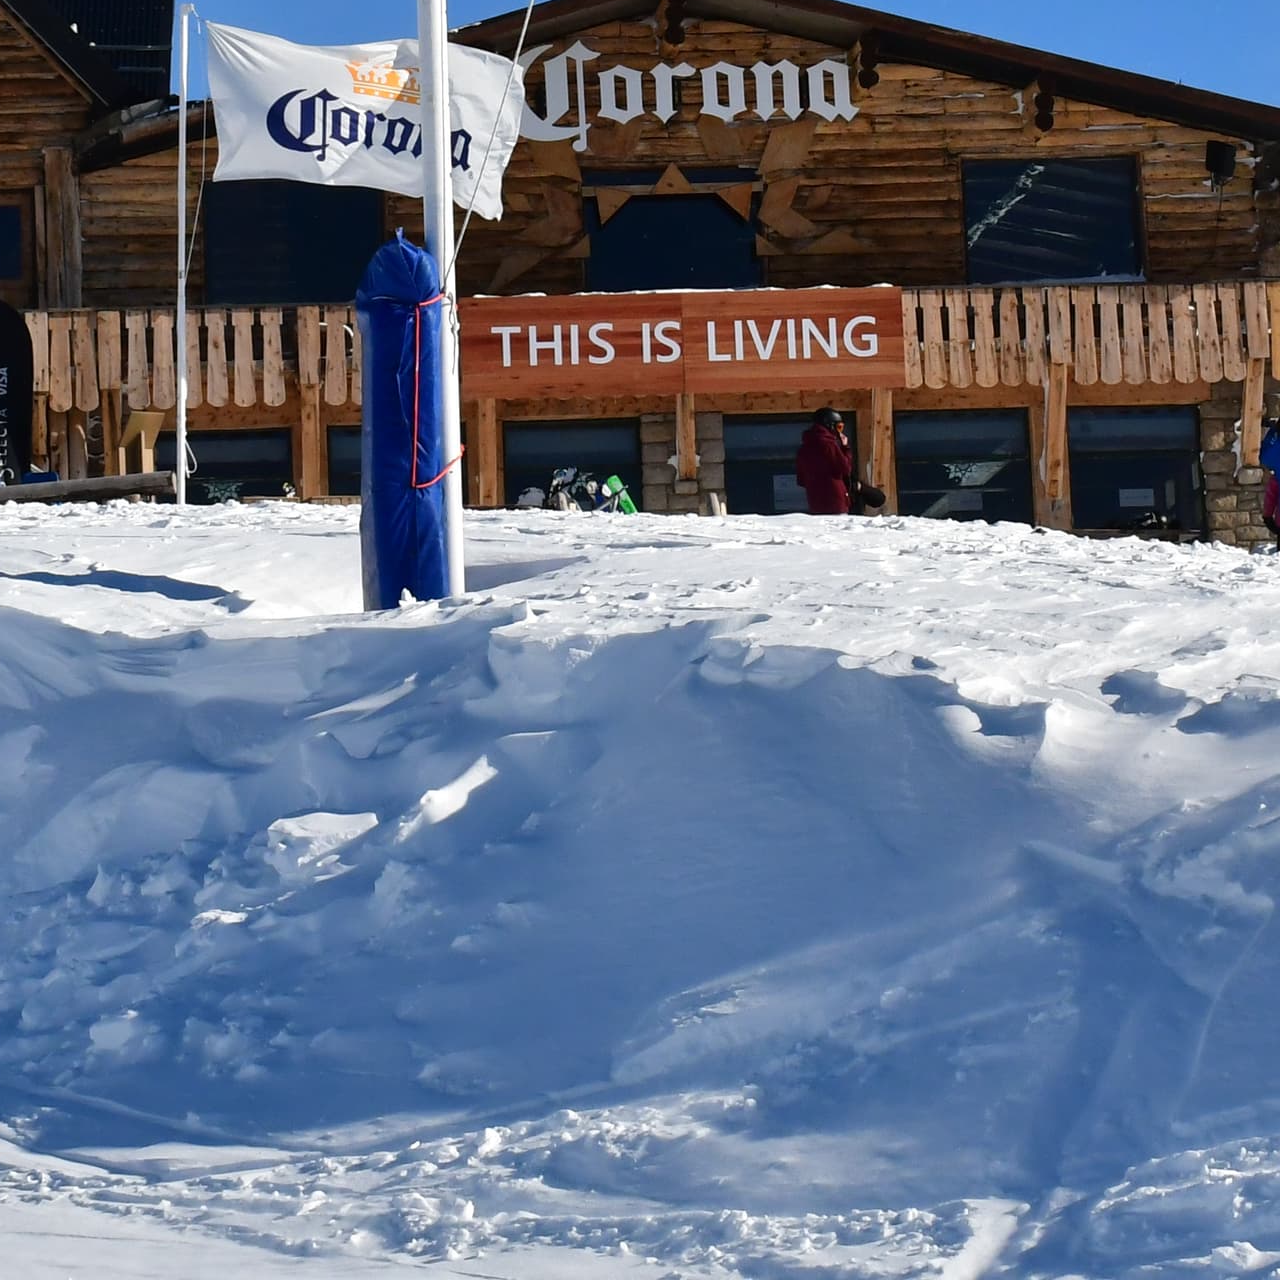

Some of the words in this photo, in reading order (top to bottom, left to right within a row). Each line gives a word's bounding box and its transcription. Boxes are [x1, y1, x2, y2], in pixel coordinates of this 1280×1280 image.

[266, 88, 472, 171] Coroa
[519, 40, 860, 152] Corona
[491, 322, 616, 367] THIS
[641, 320, 682, 363] IS
[707, 315, 879, 361] LIVING
